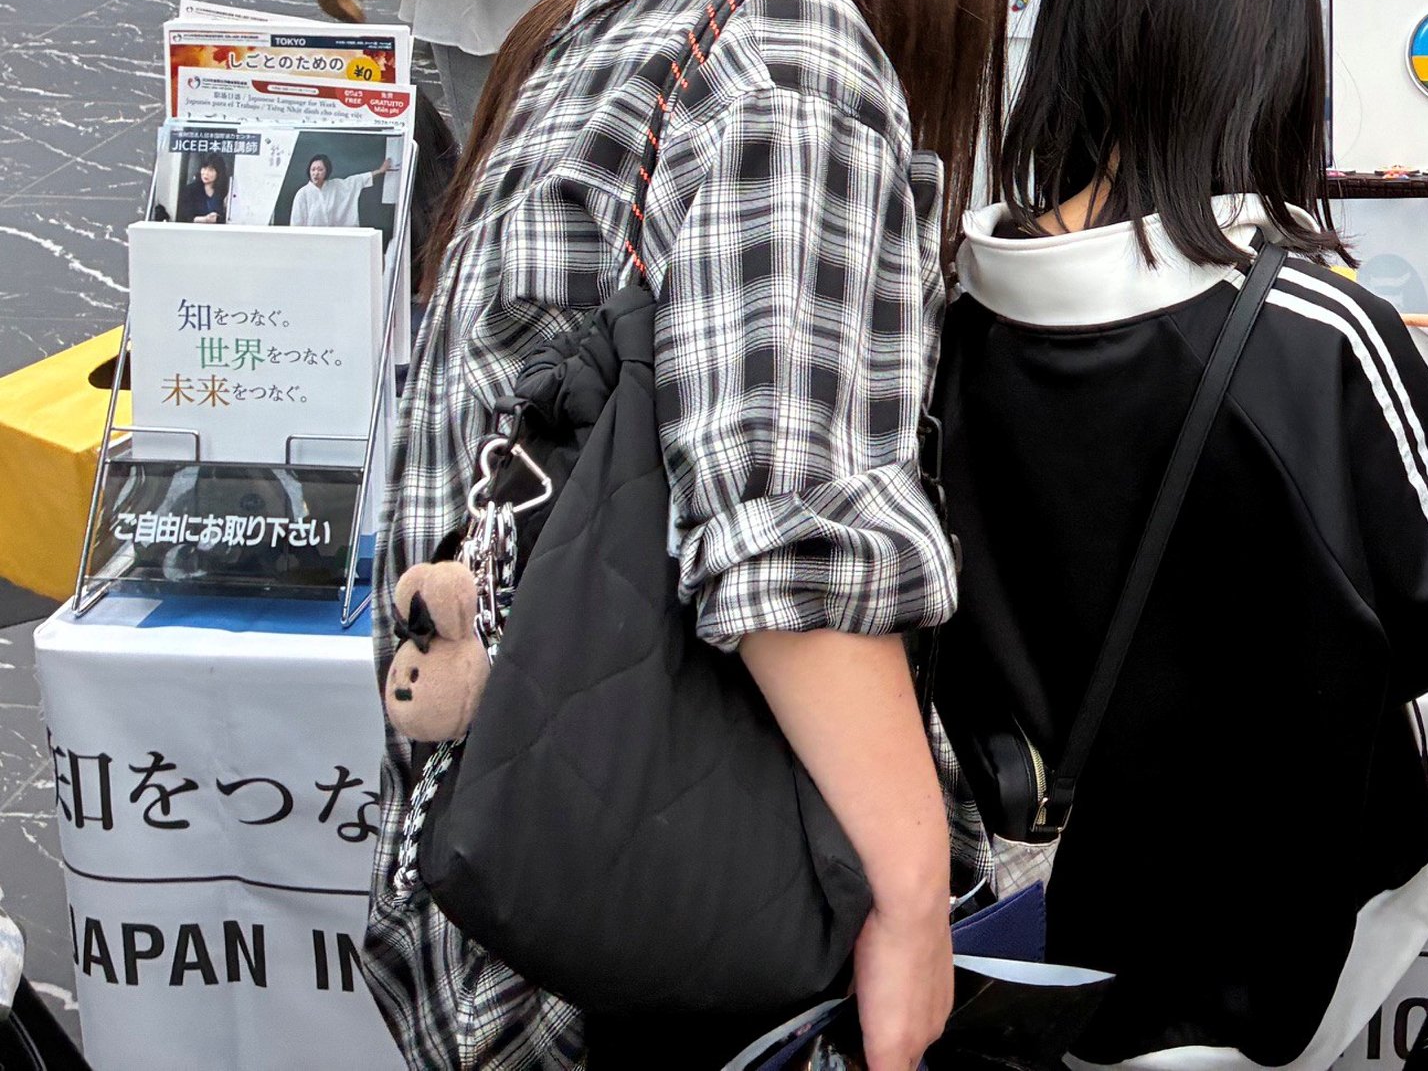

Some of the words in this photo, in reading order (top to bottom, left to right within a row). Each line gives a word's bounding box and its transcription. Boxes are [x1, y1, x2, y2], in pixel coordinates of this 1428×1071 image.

[275, 37, 306, 47] TOKYO
[228, 53, 344, 71] しごとのための
[353, 65, 372, 81] ¥0
[345, 96, 362, 105] FREE
[370, 98, 404, 108] GRATUITO
[171, 139, 259, 154] JICE日本語講師
[176, 298, 291, 332] 知をつなぐ。
[195, 337, 343, 372] 世界をつなぐ。
[160, 372, 308, 408] 未来をつなぐ。
[113, 510, 332, 548] ご自由にお取り下さい
